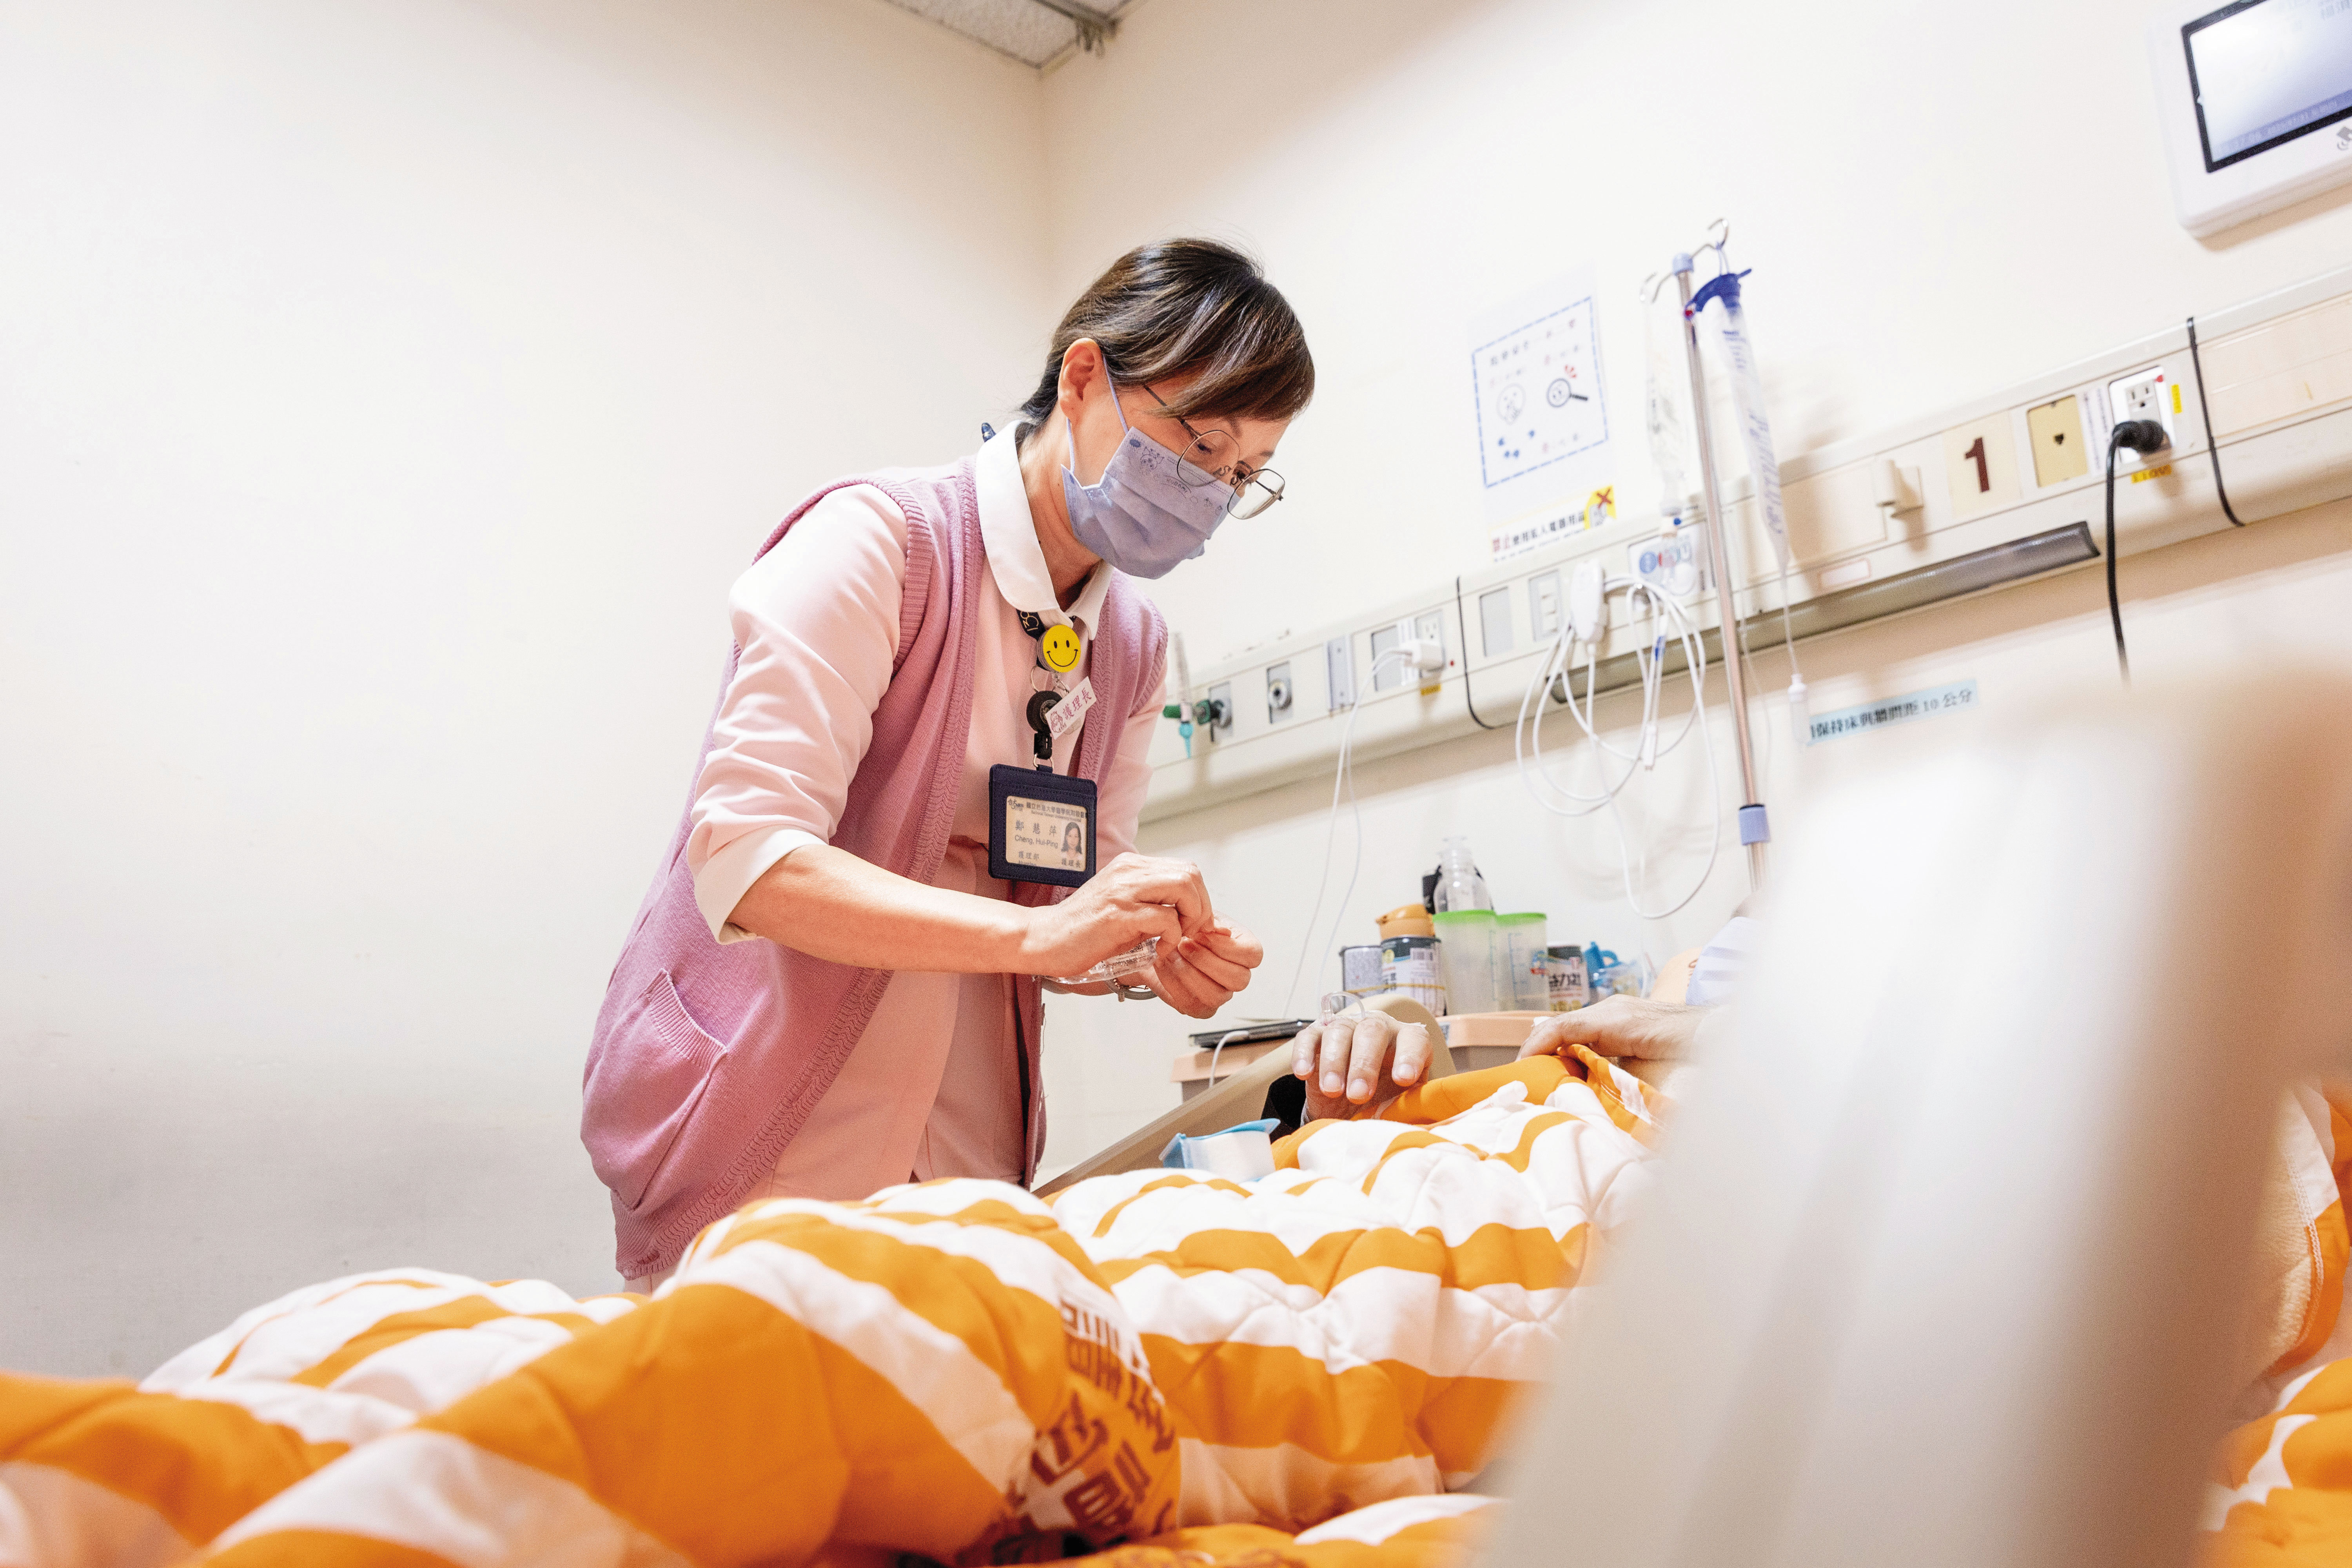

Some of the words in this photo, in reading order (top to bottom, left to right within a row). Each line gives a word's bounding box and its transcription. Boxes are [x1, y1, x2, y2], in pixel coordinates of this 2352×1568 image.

[1965, 437, 1990, 493] 1
[1062, 688, 1092, 719] 護理長
[1014, 834, 1034, 845] Cheng,
[1036, 838, 1058, 849] Hui-Ping
